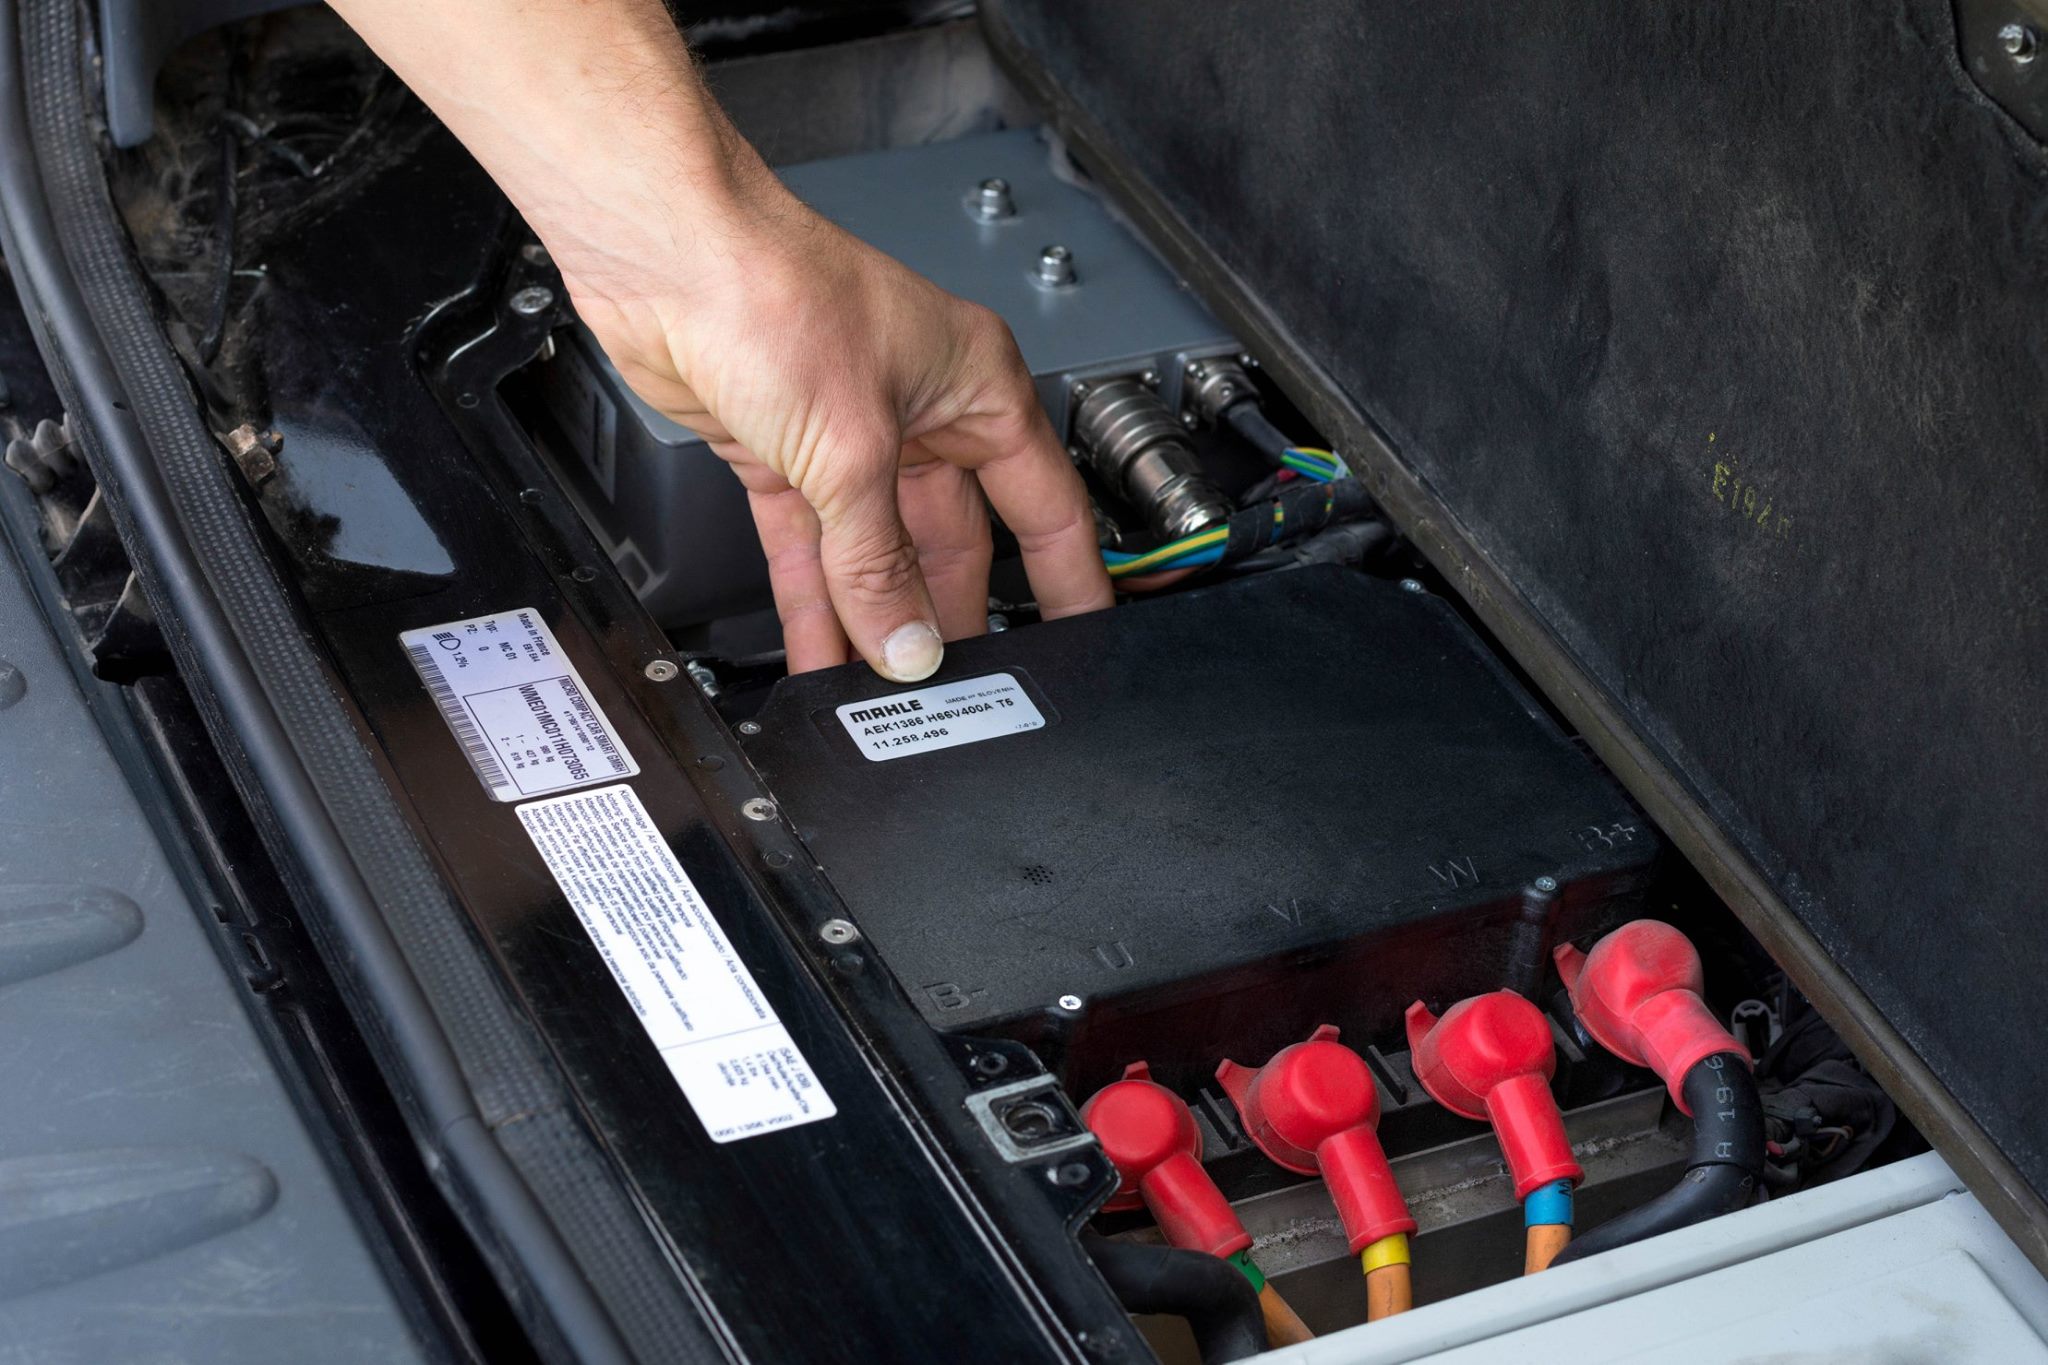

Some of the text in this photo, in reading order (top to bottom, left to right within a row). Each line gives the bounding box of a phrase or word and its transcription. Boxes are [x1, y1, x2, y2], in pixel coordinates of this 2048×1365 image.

[517, 612, 534, 629] Made
[531, 635, 551, 656] France
[498, 641, 513, 653] MC
[848, 699, 924, 724] MAHLE
[864, 716, 924, 736] AEK1386
[925, 702, 994, 723] H66V400A
[558, 678, 626, 773] MICRO COMPACT CAR SMART GMBH
[872, 727, 949, 750] 11.258.496
[618, 789, 648, 830] Klimaanlage
[610, 821, 629, 843] Service
[619, 817, 638, 839] Service
